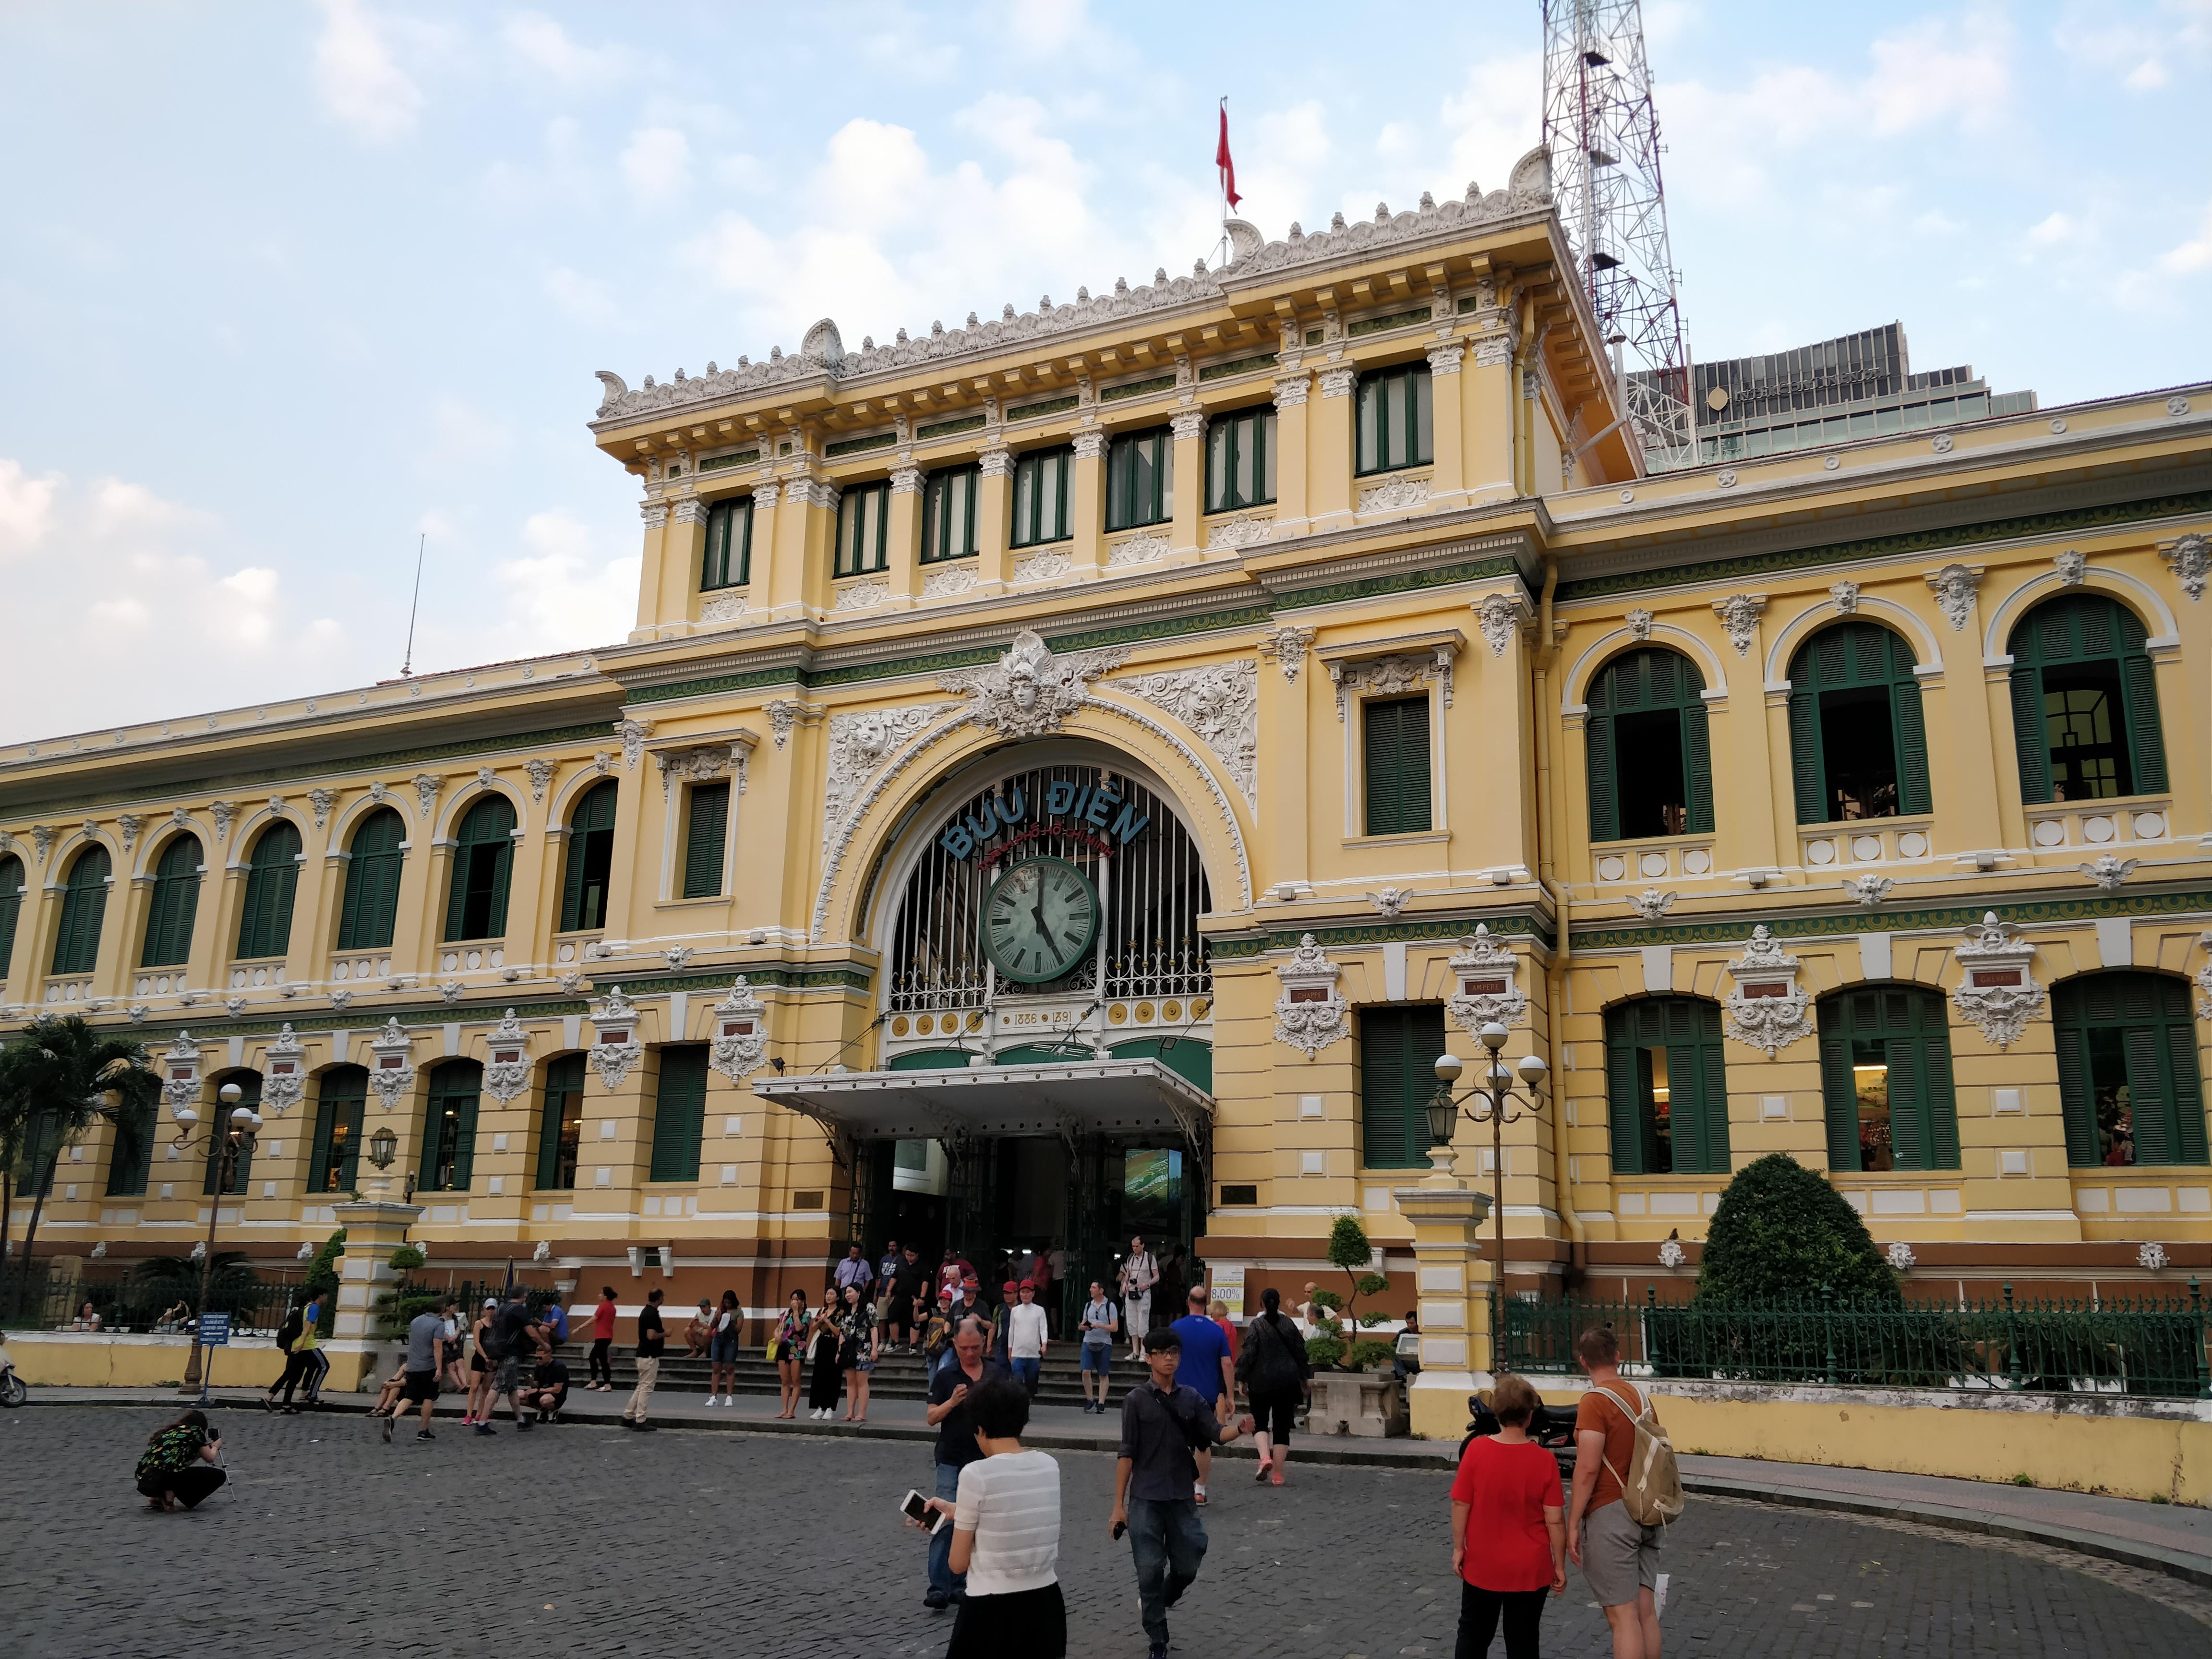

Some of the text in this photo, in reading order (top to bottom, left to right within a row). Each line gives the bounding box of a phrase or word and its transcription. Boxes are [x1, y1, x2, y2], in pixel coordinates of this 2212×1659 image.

[940, 781, 1150, 860] BƯU ĐIỆN
[1044, 820, 1062, 835] HỒ
[1066, 828, 1089, 841] CHÍ
[1085, 835, 1116, 858] MINH
[1472, 983, 1499, 991] AMPERE
[1014, 1011, 1072, 1025] 1886 1891
[1212, 1288, 1239, 1299] 8,00%
